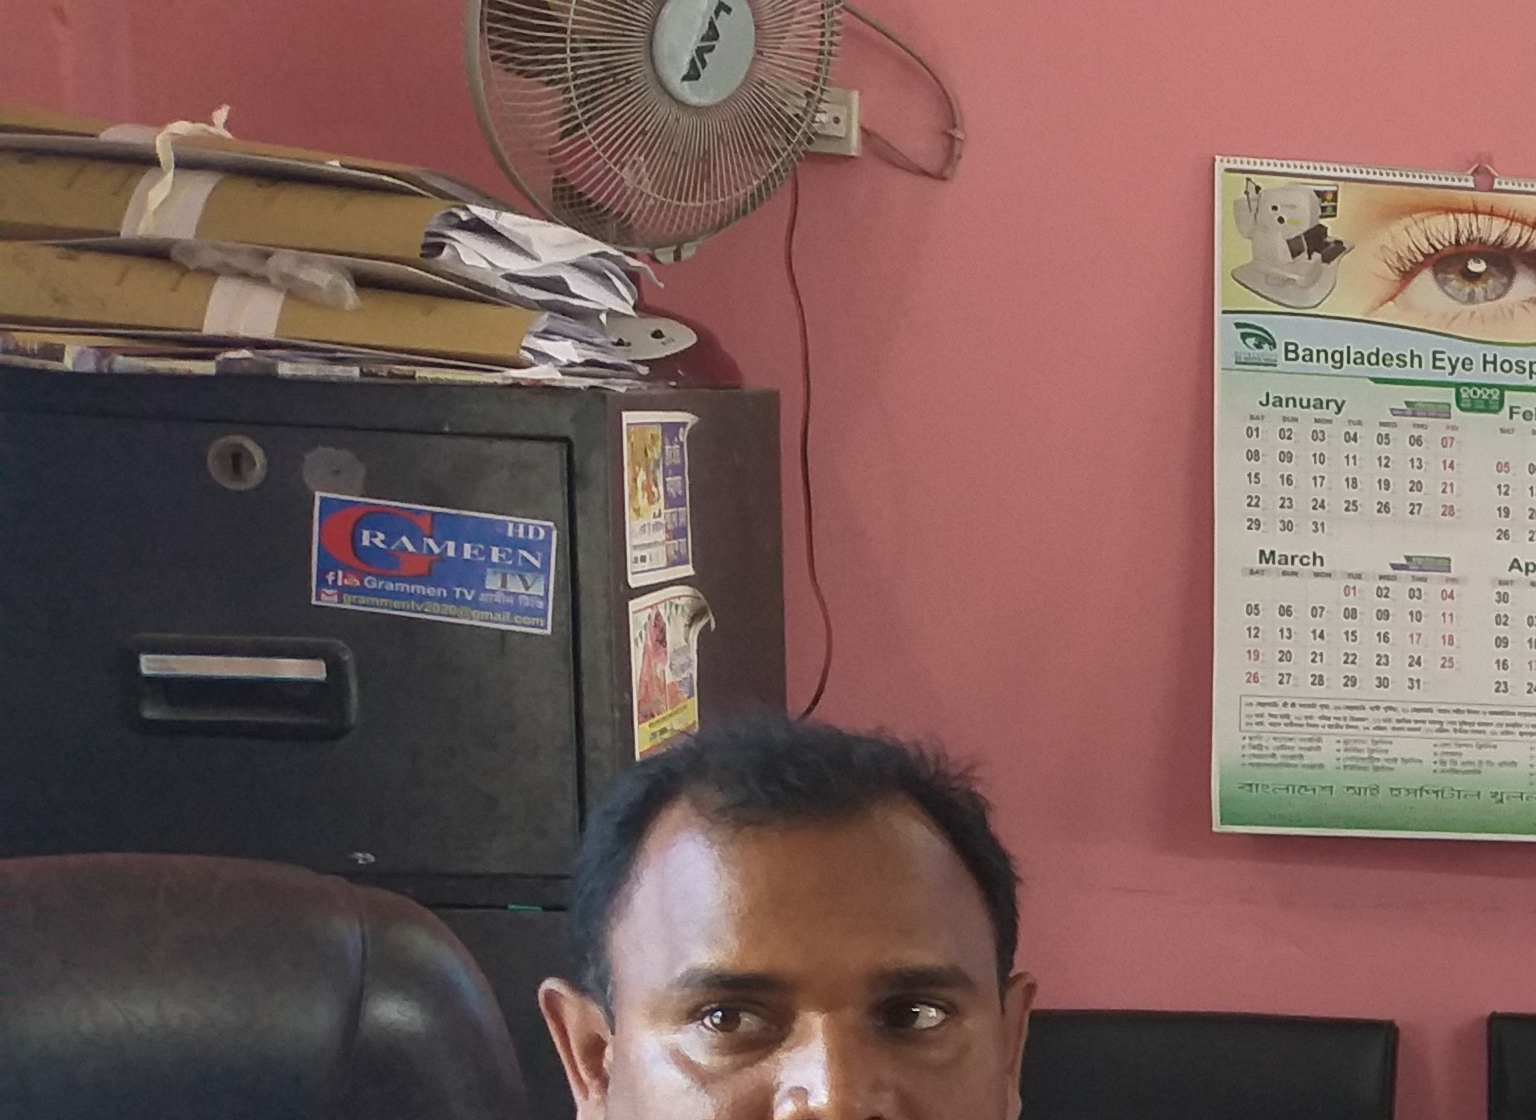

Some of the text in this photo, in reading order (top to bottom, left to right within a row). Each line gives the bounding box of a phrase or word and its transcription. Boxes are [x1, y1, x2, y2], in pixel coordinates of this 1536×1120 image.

[680, 0, 732, 81] LAVA
[1284, 341, 1422, 370] Bangladesh
[1432, 351, 1474, 376] Eye
[1259, 392, 1345, 415] January
[1246, 426, 1455, 448] 01 02 03 04 05 06 07
[1246, 449, 1454, 471] 08 09 10 11 12 13 14
[1496, 461, 1510, 473] 05
[1247, 472, 1453, 494] 15 16 17 18 19 20 21
[1497, 484, 1510, 496] 12
[1247, 495, 1260, 508] 22
[1279, 497, 1293, 509] 23
[1312, 498, 1326, 510] 24
[1344, 500, 1358, 512] 25
[1377, 501, 1390, 514] 26
[1409, 502, 1422, 515] 27
[1497, 506, 1510, 518] 19
[507, 523, 545, 541] HD
[1247, 518, 1324, 533] 29 30 31
[1496, 528, 1510, 540] 26
[1259, 550, 1324, 567] March
[364, 575, 475, 601] Grammen TV
[493, 572, 540, 591] TV
[1343, 585, 1454, 601] 01 02 03 04
[1495, 591, 1509, 604] 30
[1246, 603, 1453, 624] 05 06 07 08 09 10 11
[1495, 614, 1509, 626] 02
[1247, 626, 1260, 638] 12
[1279, 627, 1292, 640] 13
[1311, 629, 1325, 641] 14
[1344, 630, 1357, 642] 15
[1377, 631, 1390, 643] 16
[1409, 632, 1422, 644] 17
[1495, 636, 1509, 648] 09
[1247, 649, 1260, 661] 19
[1278, 650, 1292, 662] 20
[1311, 651, 1323, 663] 21
[1343, 652, 1357, 665] 22
[1376, 654, 1389, 666] 23
[1408, 655, 1421, 667] 24
[1495, 659, 1509, 671] 16
[1246, 672, 1421, 690] 26 27 28 29 30 31
[1494, 681, 1509, 693] 23
